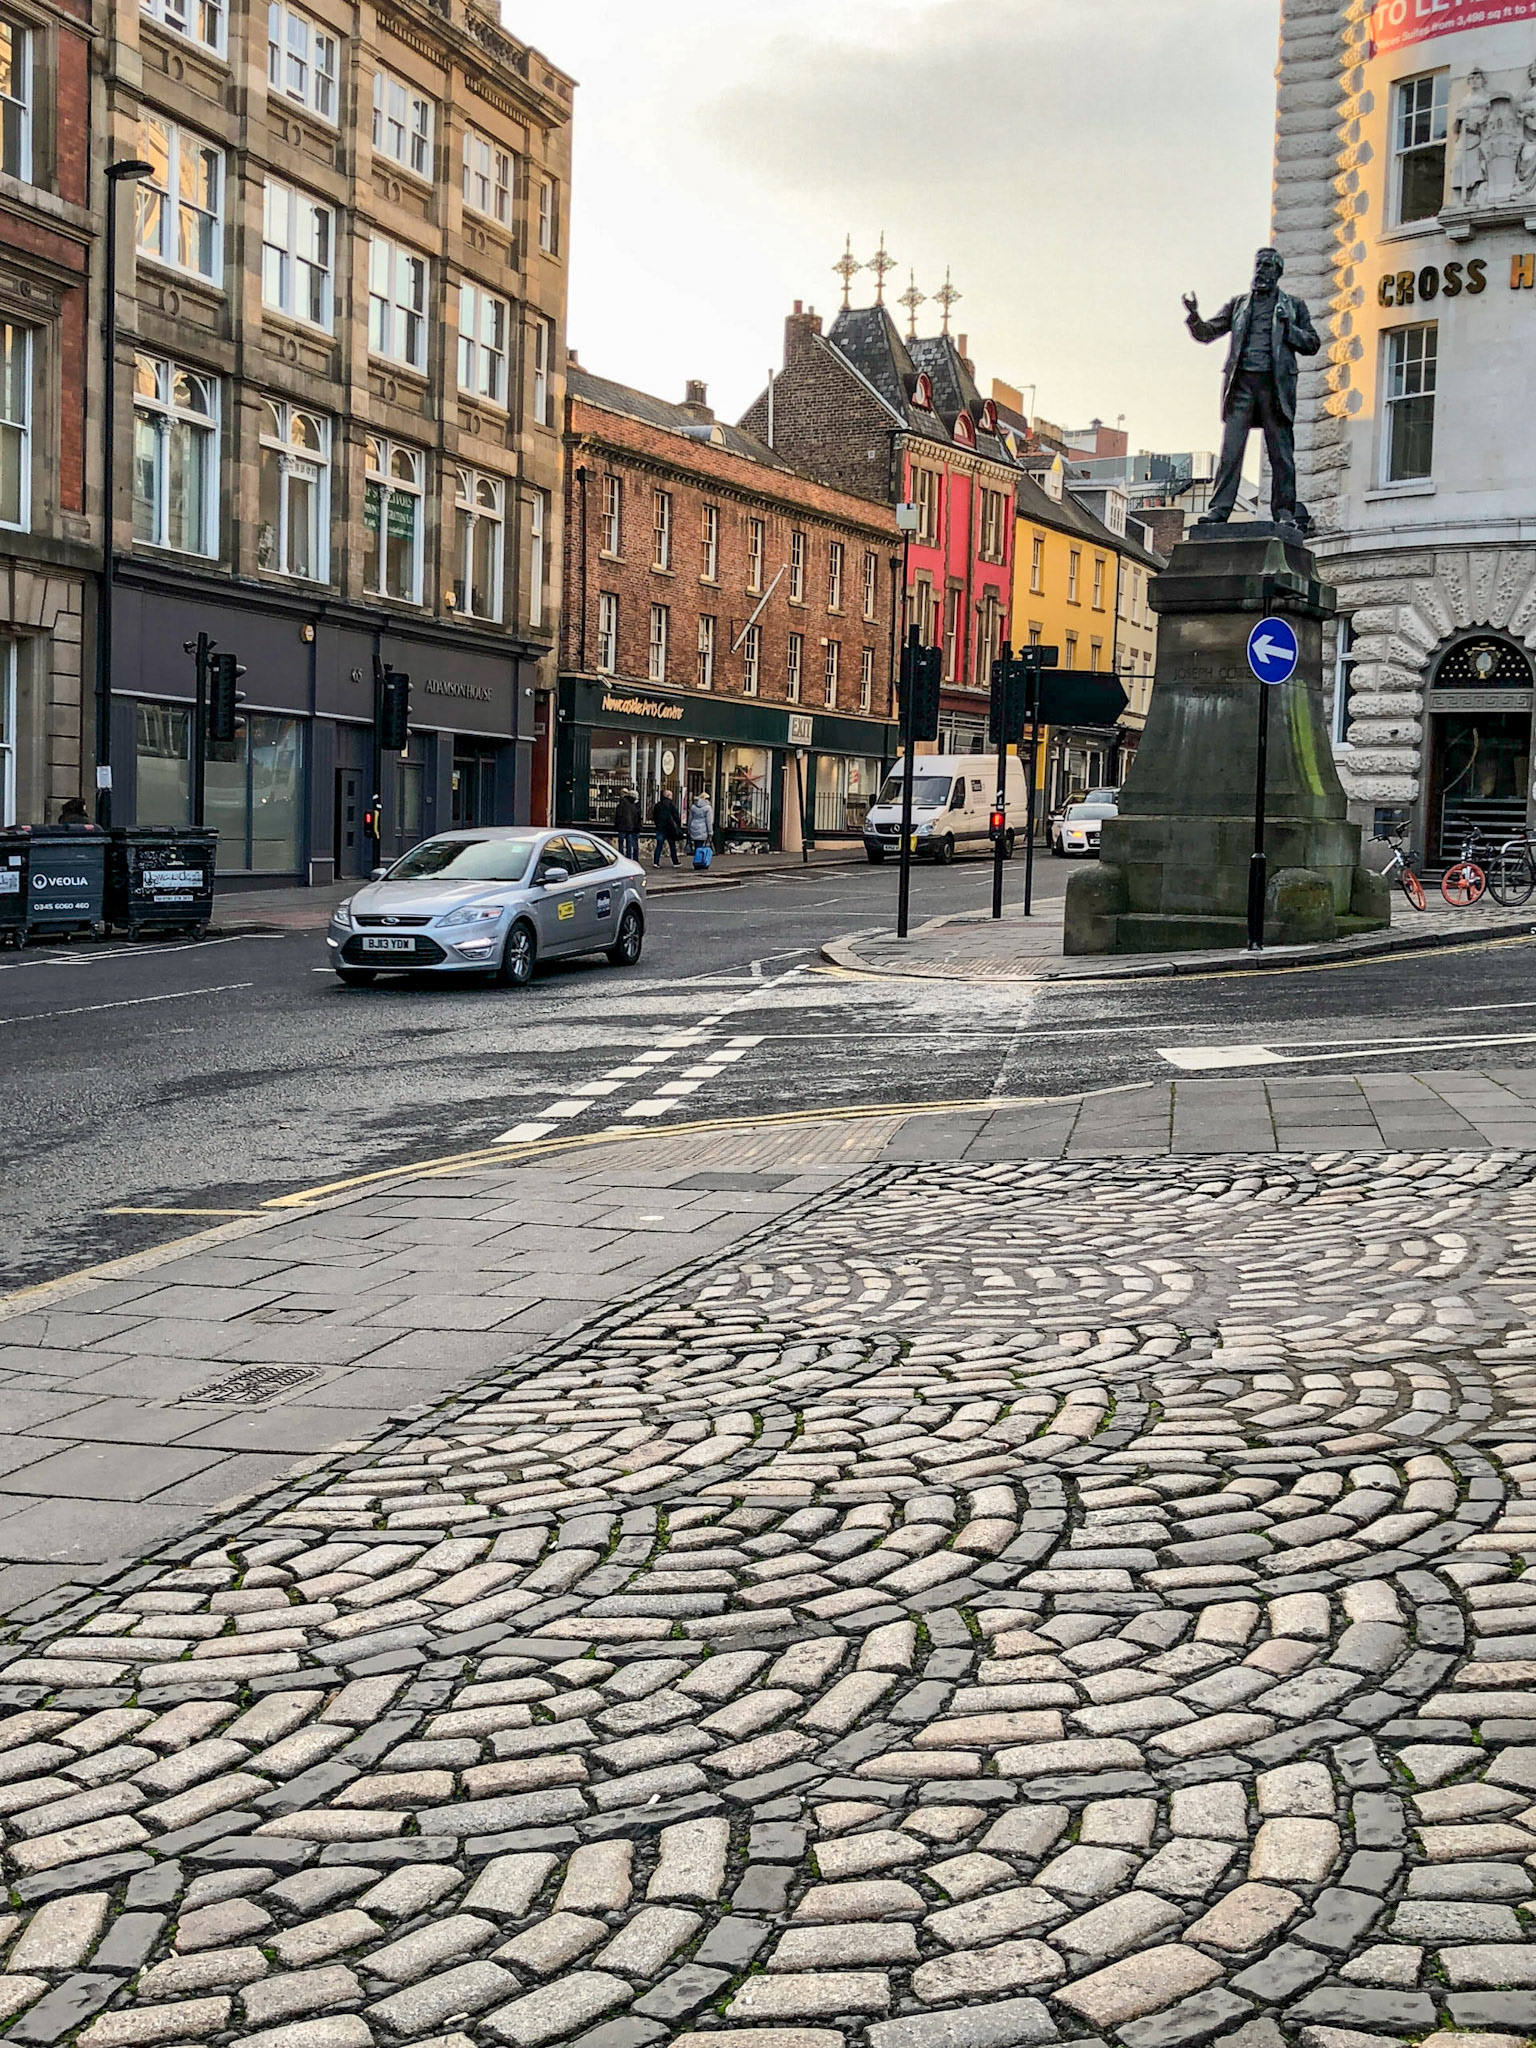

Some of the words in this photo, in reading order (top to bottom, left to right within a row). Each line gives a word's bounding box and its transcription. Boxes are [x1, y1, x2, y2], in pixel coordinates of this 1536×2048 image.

[1375, 0, 1408, 30] TO
[1431, 19, 1455, 32] from
[1487, 9, 1501, 20] sq
[1503, 6, 1513, 16] ft
[1514, 4, 1528, 15] to
[1377, 258, 1488, 308] CROSS
[1510, 253, 1536, 290] H
[1172, 666, 1213, 681] JOSEPH
[425, 680, 466, 698] ADAMSON
[466, 684, 493, 701] HOUSE
[602, 693, 643, 715] Newcastle
[641, 699, 658, 717] Arts
[657, 702, 684, 720] Centre
[792, 717, 811, 738] EXIT
[48, 877, 88, 887] VEOLIA
[33, 903, 54, 911] 0345
[54, 902, 74, 910] 6060
[368, 939, 388, 948] BJ13
